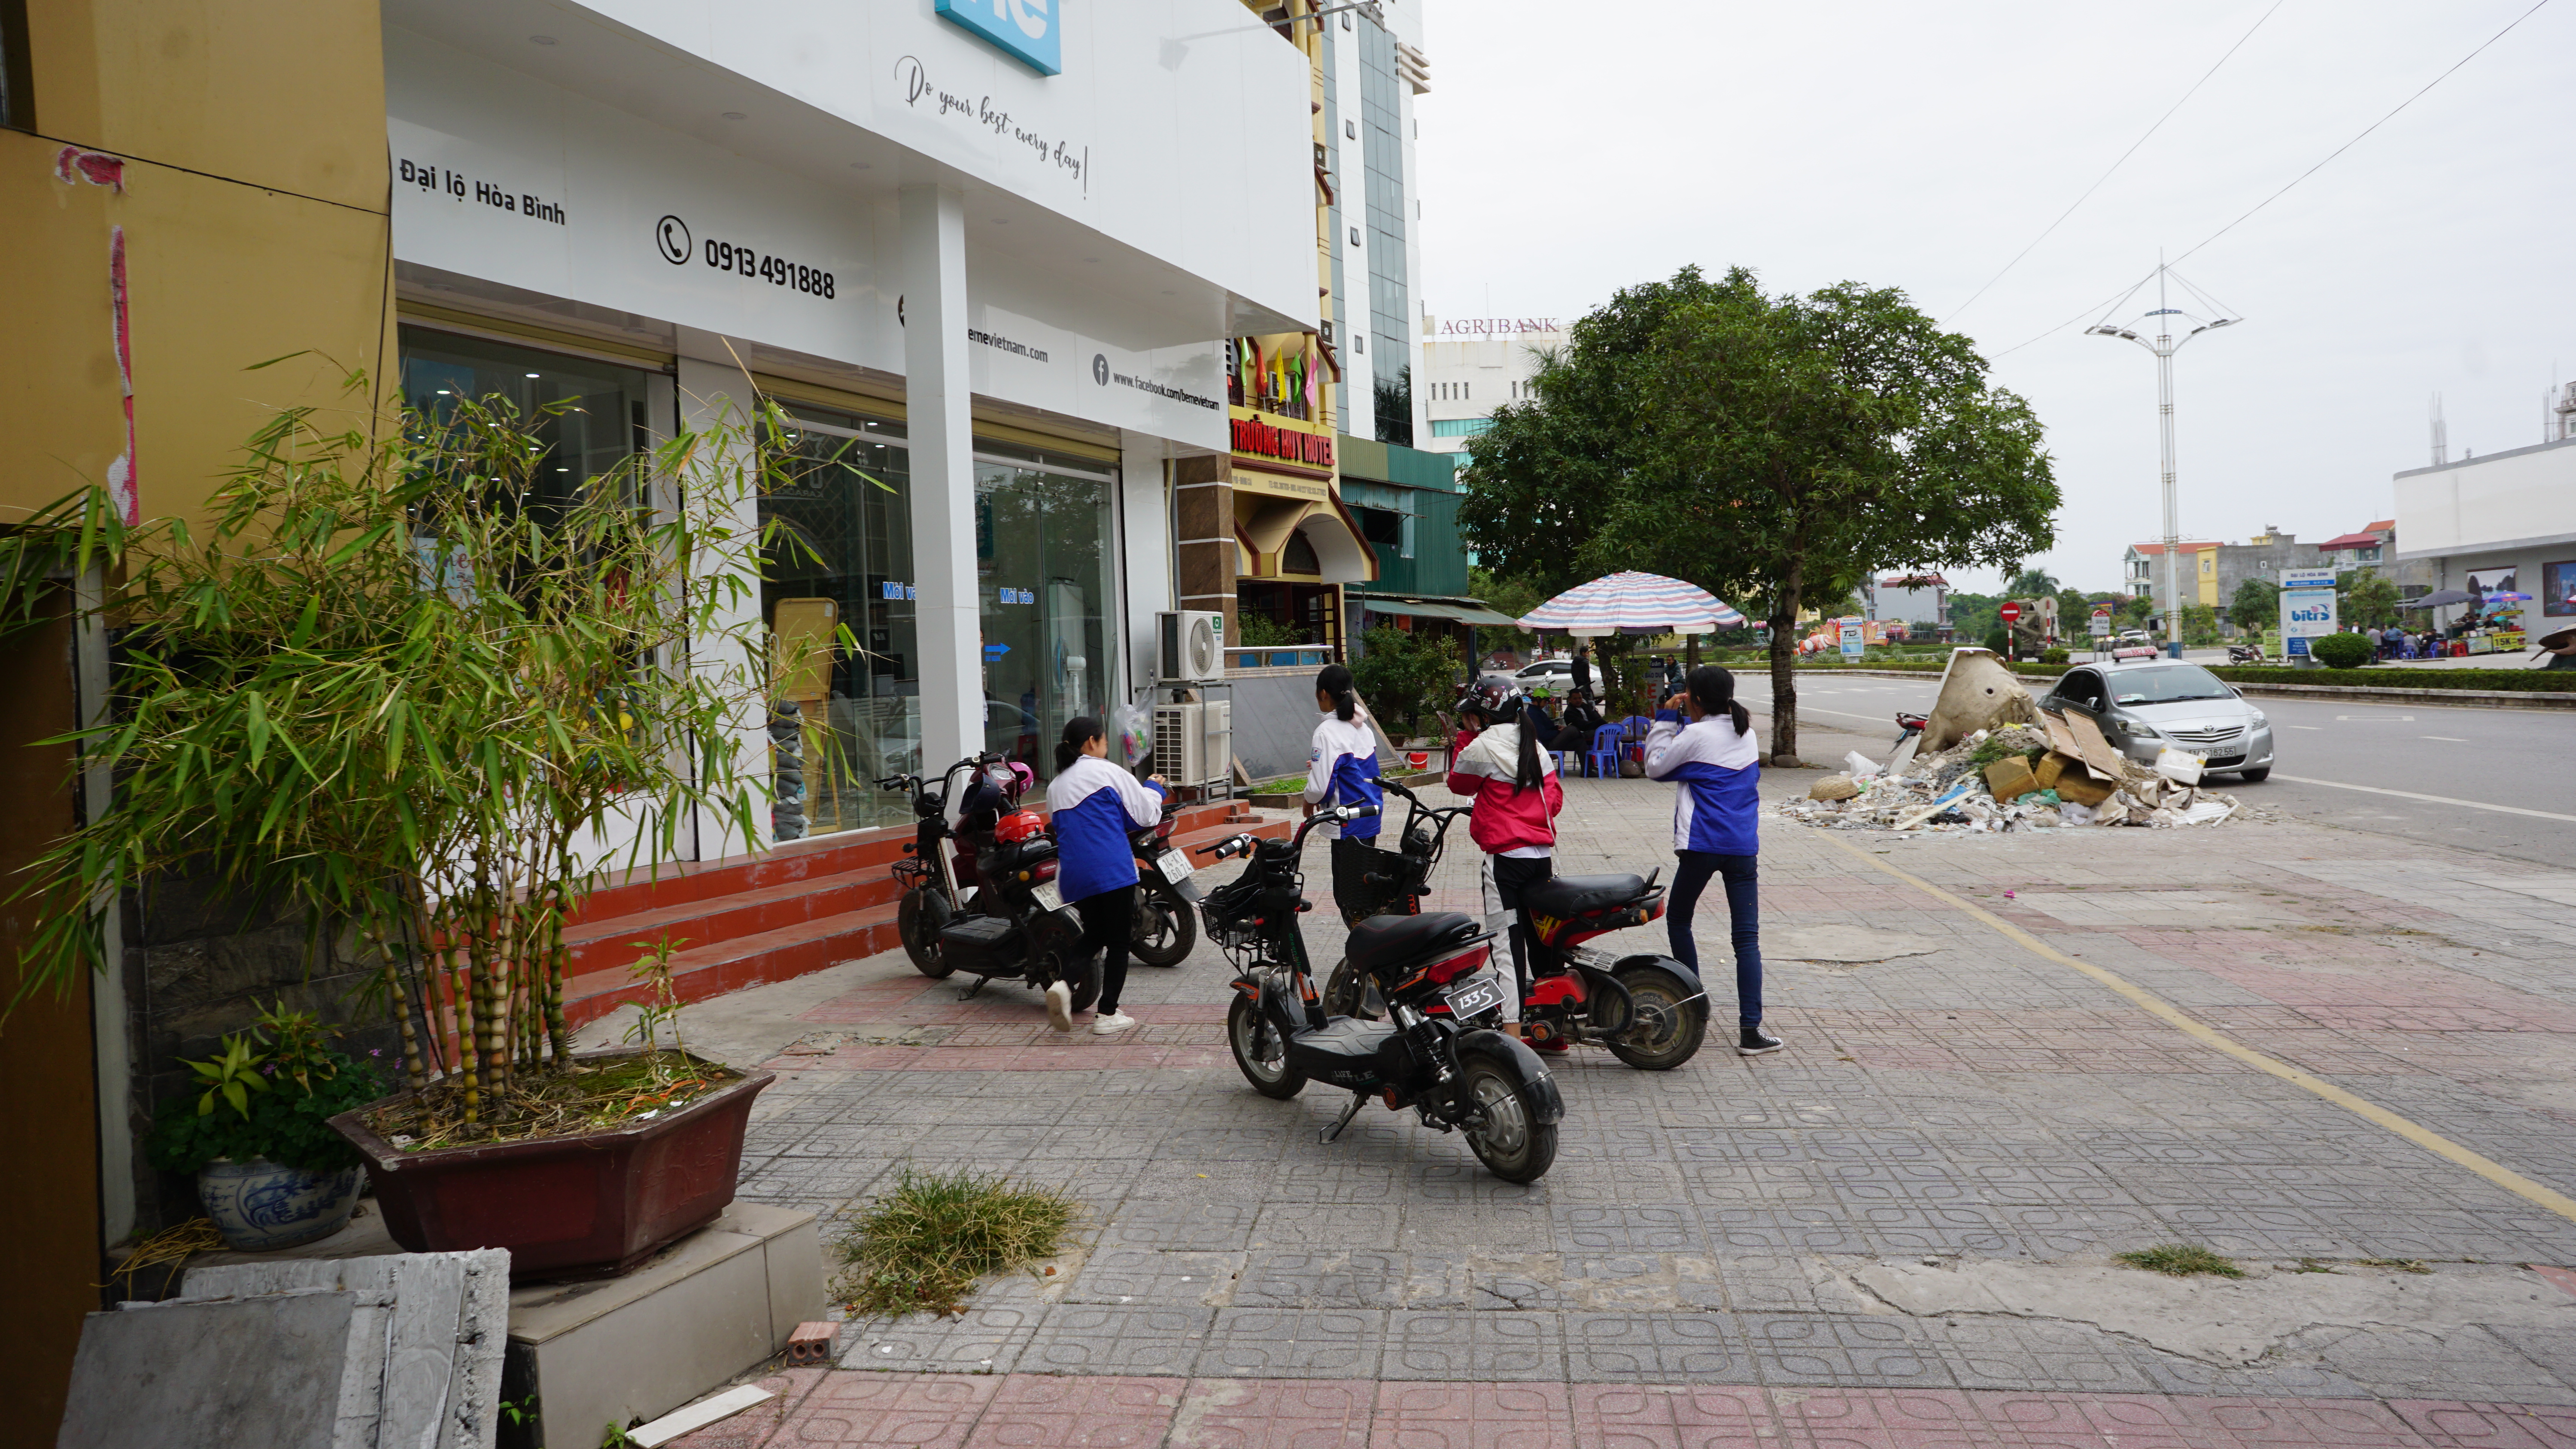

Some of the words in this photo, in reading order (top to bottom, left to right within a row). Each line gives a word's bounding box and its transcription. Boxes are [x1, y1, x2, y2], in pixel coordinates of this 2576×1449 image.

[895, 56, 933, 107] Do
[939, 91, 974, 116] your
[980, 96, 1012, 134] best
[1016, 127, 1048, 161] every
[1054, 141, 1088, 200] day!
[400, 158, 437, 192] Đại
[446, 170, 465, 202] lộ
[476, 181, 515, 211] Hòa
[522, 194, 565, 225] Bình
[1440, 318, 1559, 334] AGRIBANK
[968, 328, 1048, 363] emevietnam.com
[1279, 428, 1303, 460] HUY
[1302, 433, 1335, 466] HOTEL
[883, 582, 904, 600] Mời
[905, 582, 916, 600] và
[1000, 587, 1017, 604] Mời
[1018, 588, 1034, 604] vào
[2495, 638, 2512, 646] 15K
[1458, 986, 1493, 1009] 133S
